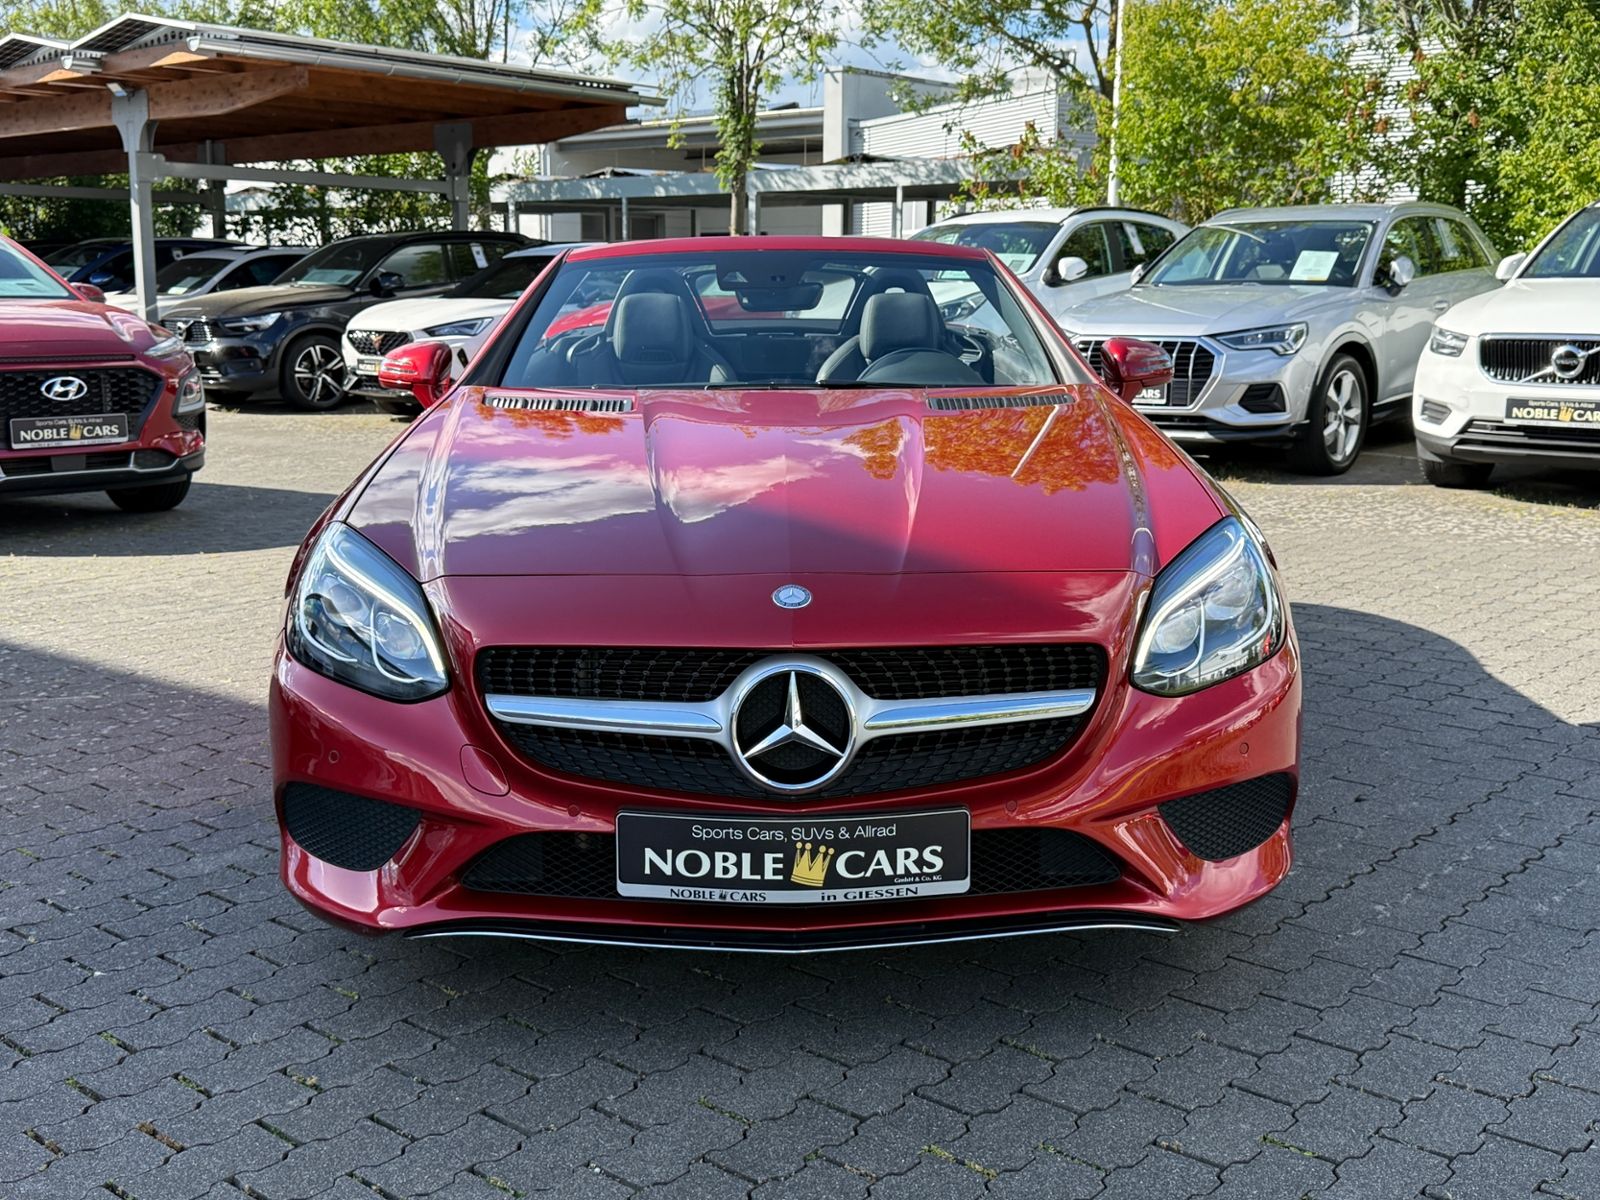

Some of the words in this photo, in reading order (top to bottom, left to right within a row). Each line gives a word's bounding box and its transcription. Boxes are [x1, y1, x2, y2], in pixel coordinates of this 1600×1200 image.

[1136, 388, 1161, 399] ARS
[1511, 406, 1559, 420] NOBLE
[20, 427, 68, 441] NOBLE
[83, 424, 119, 437] CARS
[691, 825, 743, 840] Sports
[747, 826, 788, 843] Cars,
[791, 826, 834, 841] SUVs
[838, 827, 850, 839] &
[854, 824, 897, 838] Allrad
[643, 847, 785, 881] NOBLE
[835, 844, 945, 880] CARS
[670, 888, 715, 900] NOBLE
[729, 891, 767, 902] CARS
[821, 892, 837, 901] in
[843, 886, 918, 900] GIESSEN
